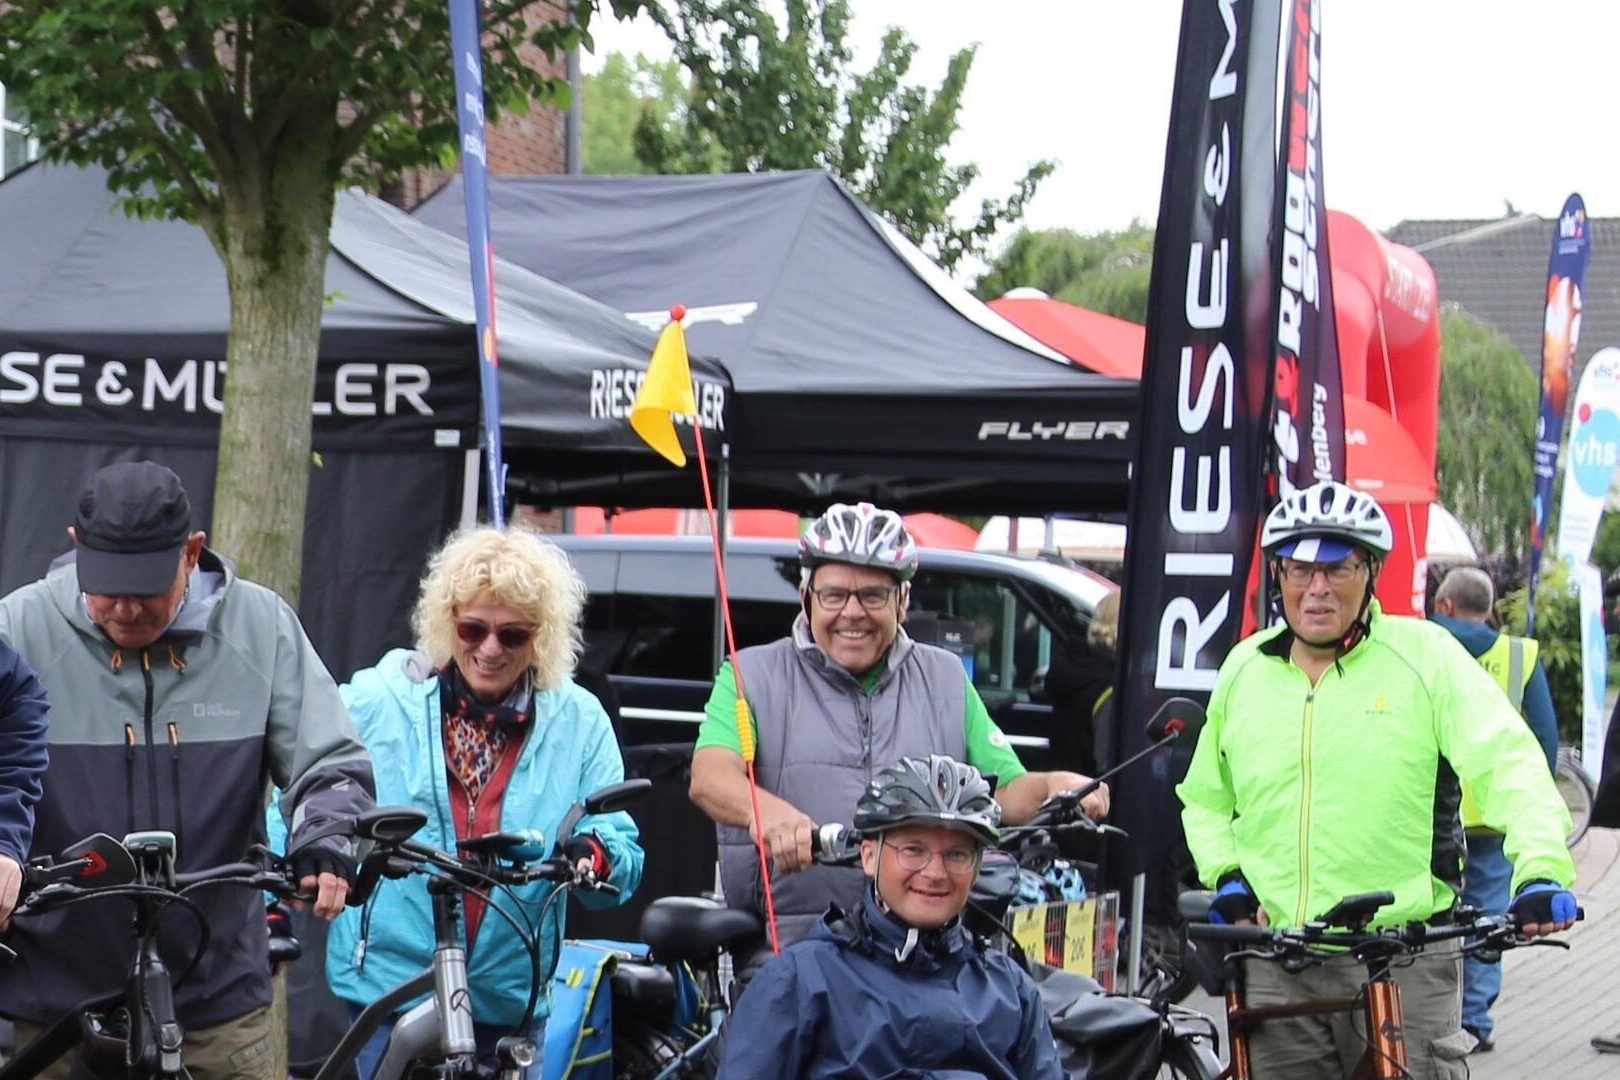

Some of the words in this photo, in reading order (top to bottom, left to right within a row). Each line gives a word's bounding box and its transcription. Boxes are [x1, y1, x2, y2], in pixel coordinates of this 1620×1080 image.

[95, 360, 134, 402] &
[1154, 238, 1236, 689] RIESE
[1203, 121, 1231, 206] &
[978, 420, 1130, 441] FLYER
[1574, 434, 1618, 468] vhs
